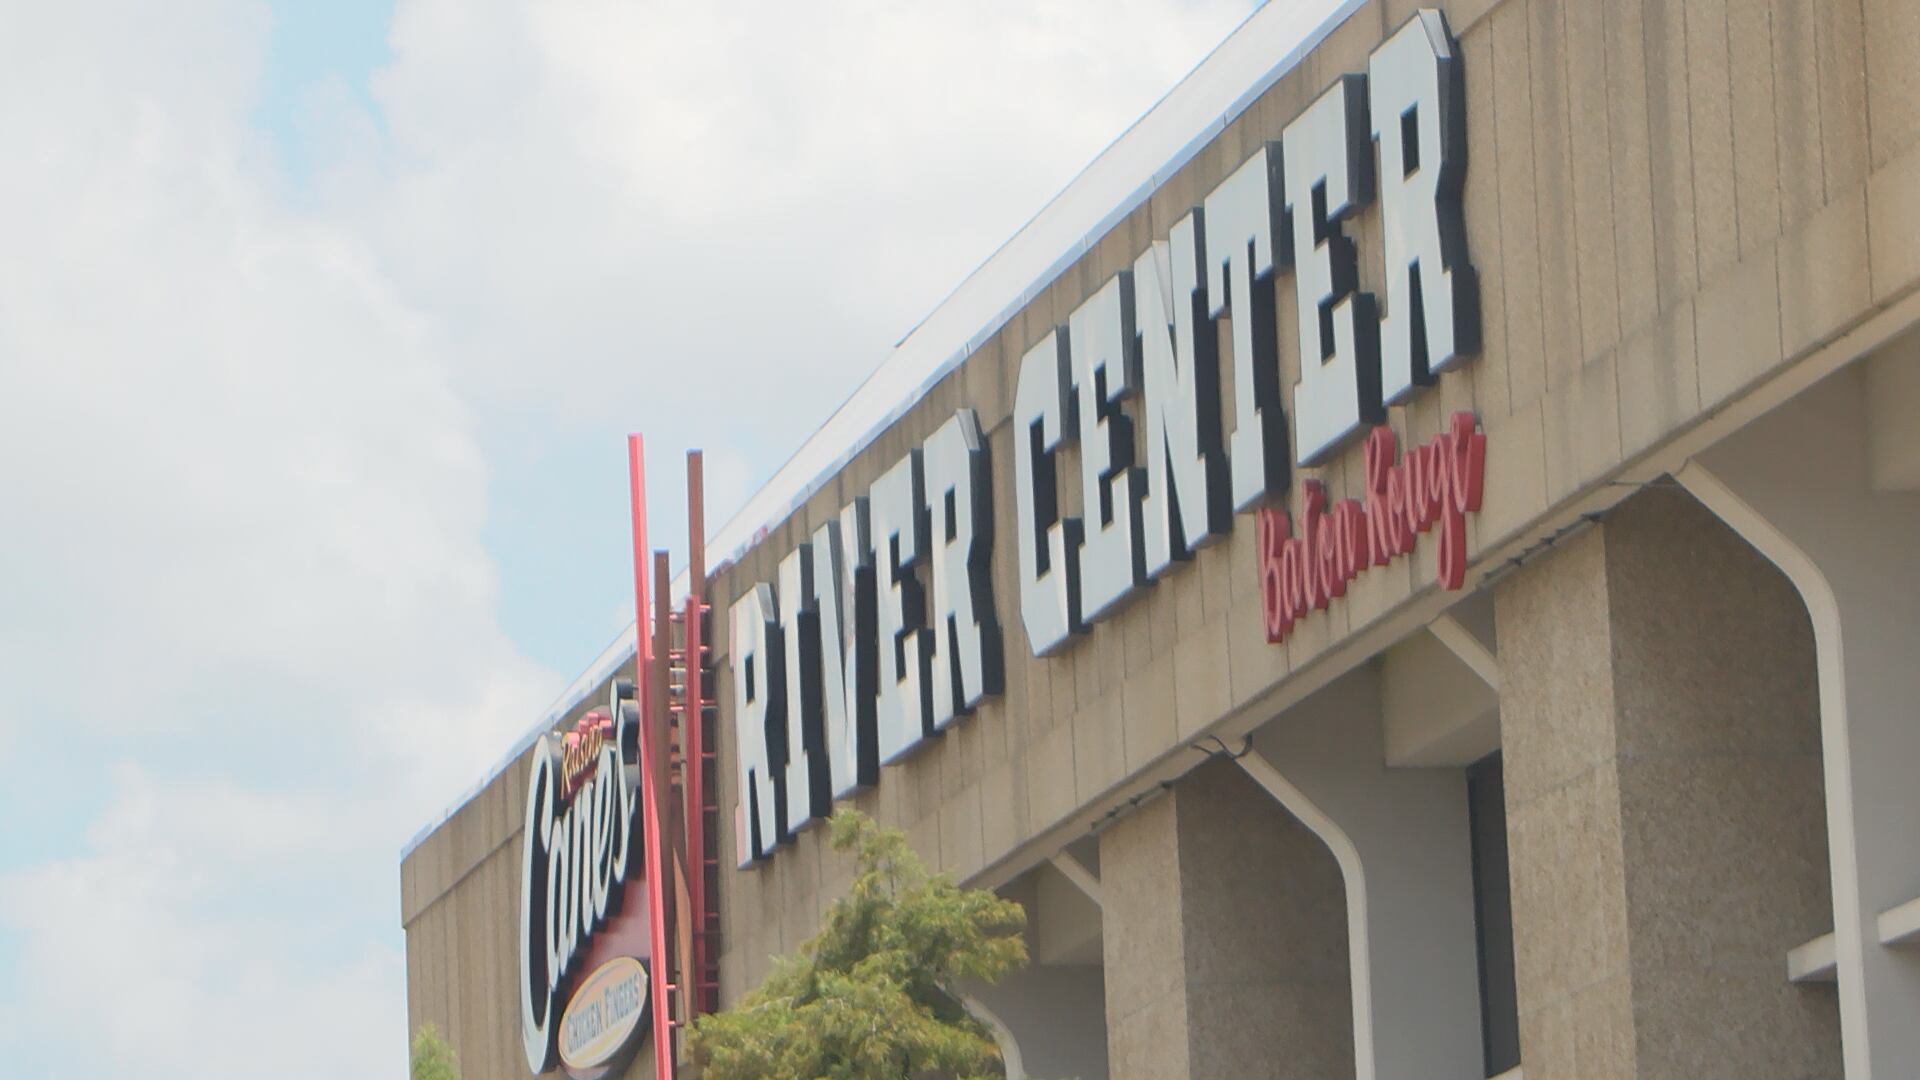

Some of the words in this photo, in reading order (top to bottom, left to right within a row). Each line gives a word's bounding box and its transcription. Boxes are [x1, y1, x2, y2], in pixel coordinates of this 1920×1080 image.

[729, 408, 1002, 870] RIVER
[1014, 8, 1481, 656] CENTER
[1257, 479, 1367, 643] Baton
[1364, 411, 1486, 590] Rouge
[521, 679, 640, 1075] Cane's
